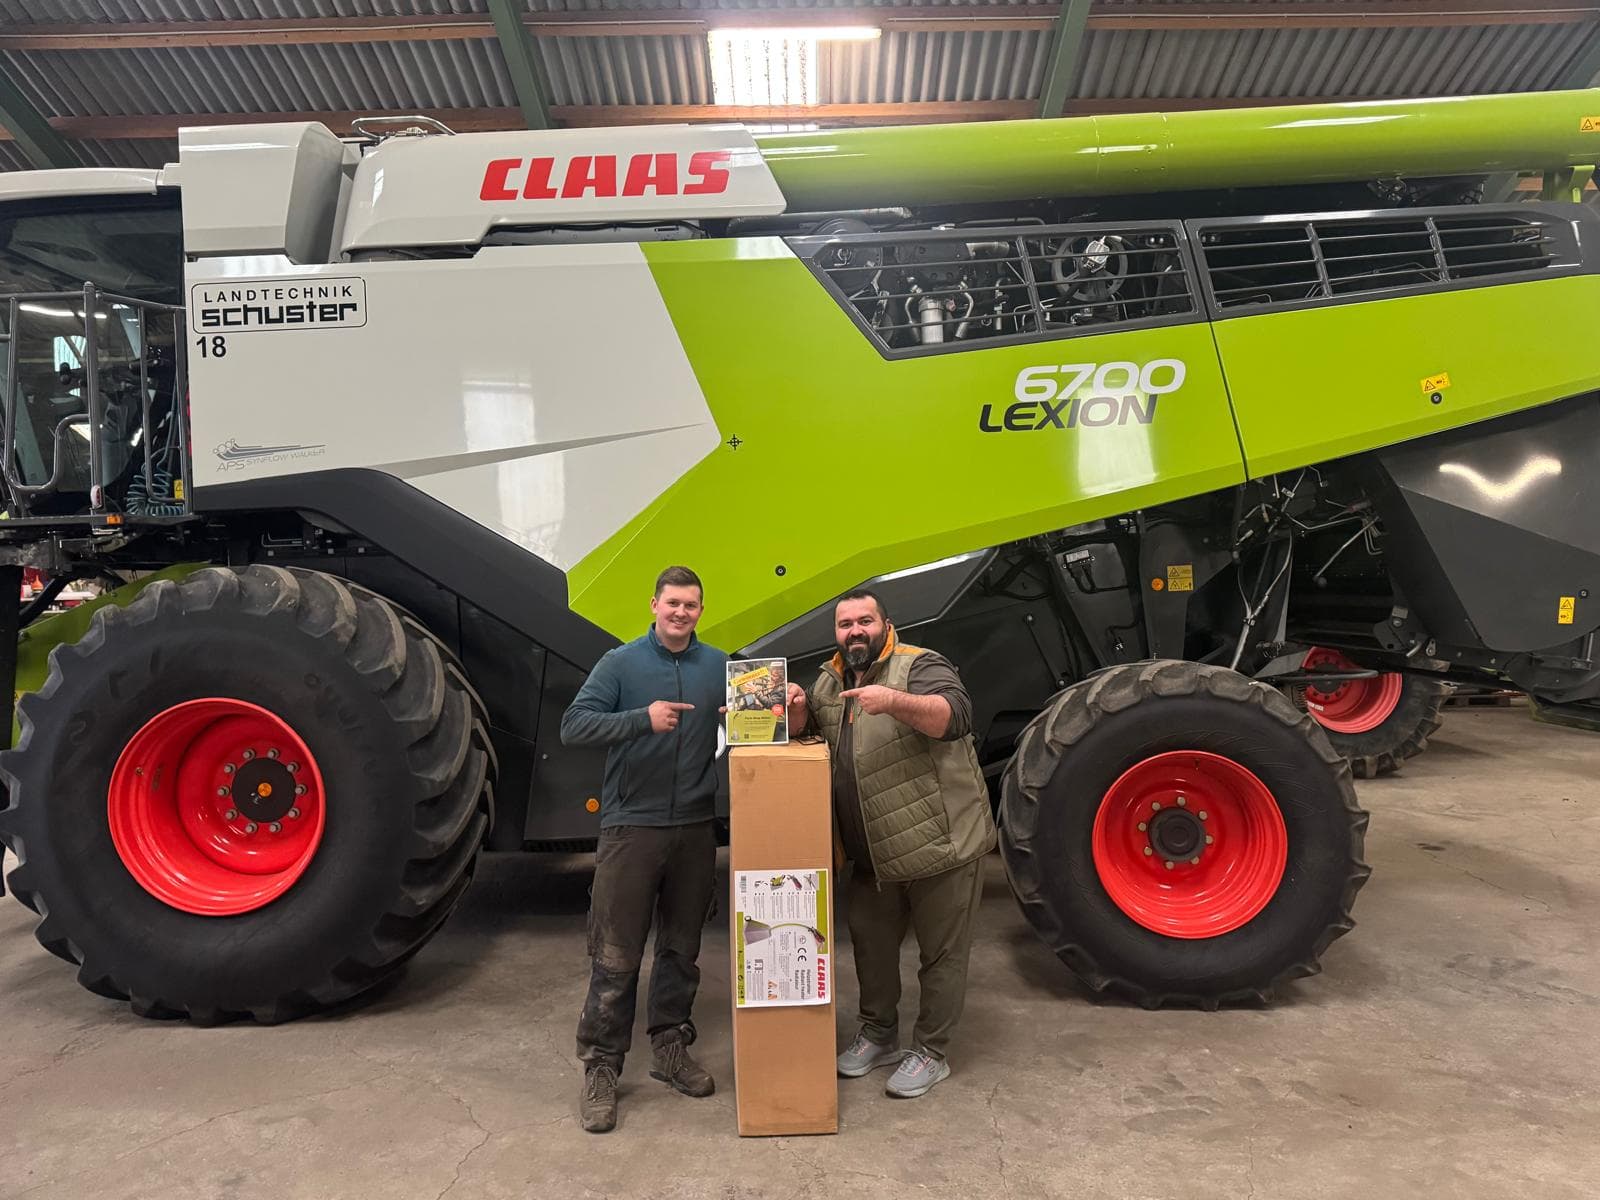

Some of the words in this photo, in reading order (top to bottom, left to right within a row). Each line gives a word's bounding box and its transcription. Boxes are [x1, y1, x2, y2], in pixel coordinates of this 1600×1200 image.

[480, 151, 732, 200] CLAAS
[204, 285, 353, 303] LANDTECHNIK
[202, 301, 358, 327] schuster
[196, 335, 227, 358] 18
[1014, 358, 1187, 402] 6700
[979, 394, 1159, 433] LEXION
[216, 460, 245, 473] APS
[817, 958, 825, 1000] CLAAS
